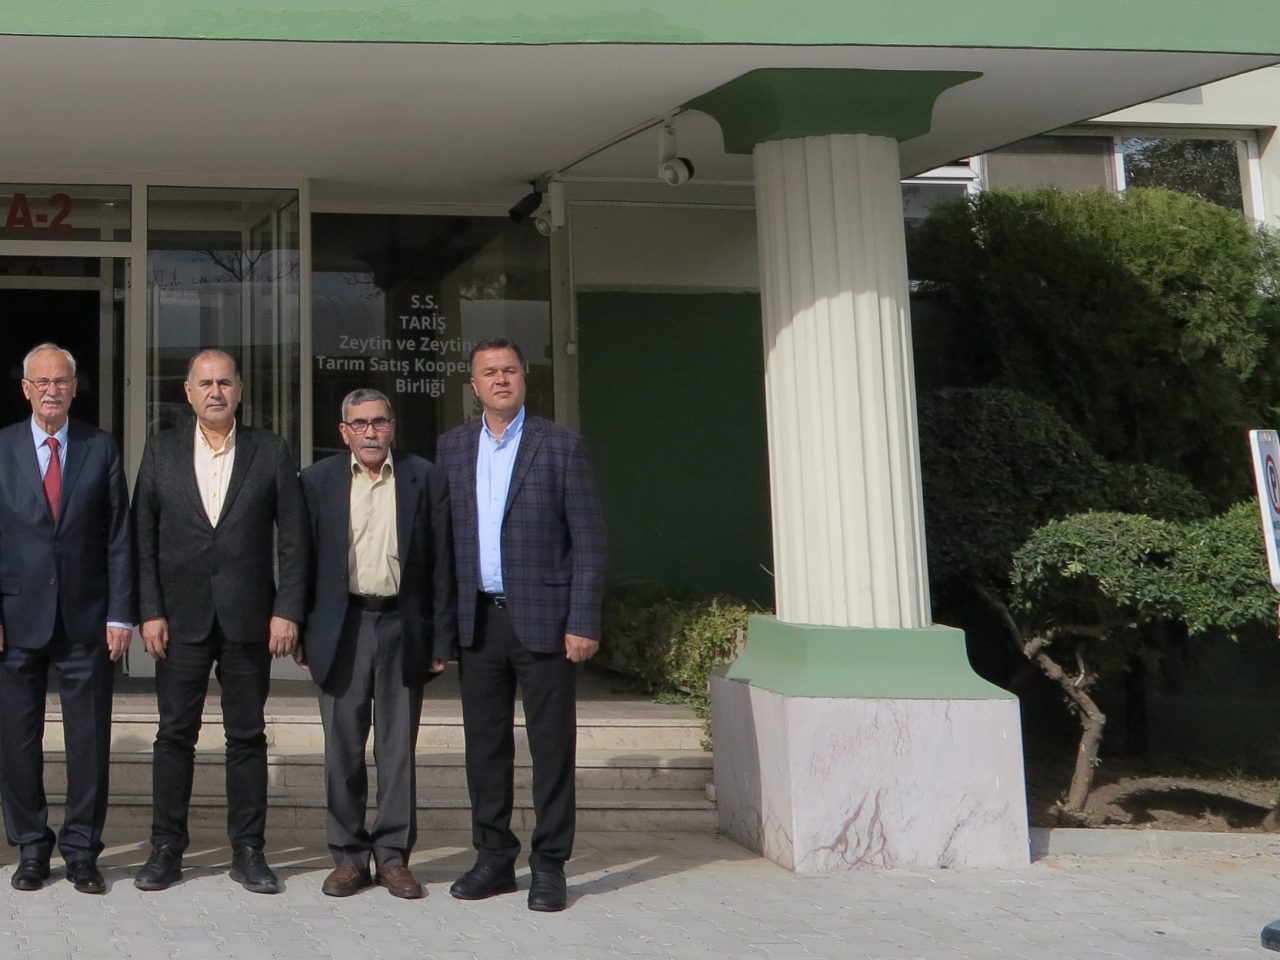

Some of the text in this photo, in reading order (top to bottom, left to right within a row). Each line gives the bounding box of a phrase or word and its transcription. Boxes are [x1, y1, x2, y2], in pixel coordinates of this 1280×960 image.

[3, 192, 74, 233] A-2
[411, 295, 438, 309] S.S.
[399, 313, 446, 334] TARİŞ
[339, 335, 477, 355] Zeytin ve Zeytin
[316, 355, 365, 371] Tarım
[369, 357, 410, 376] Satış
[395, 378, 445, 398] Birliği
